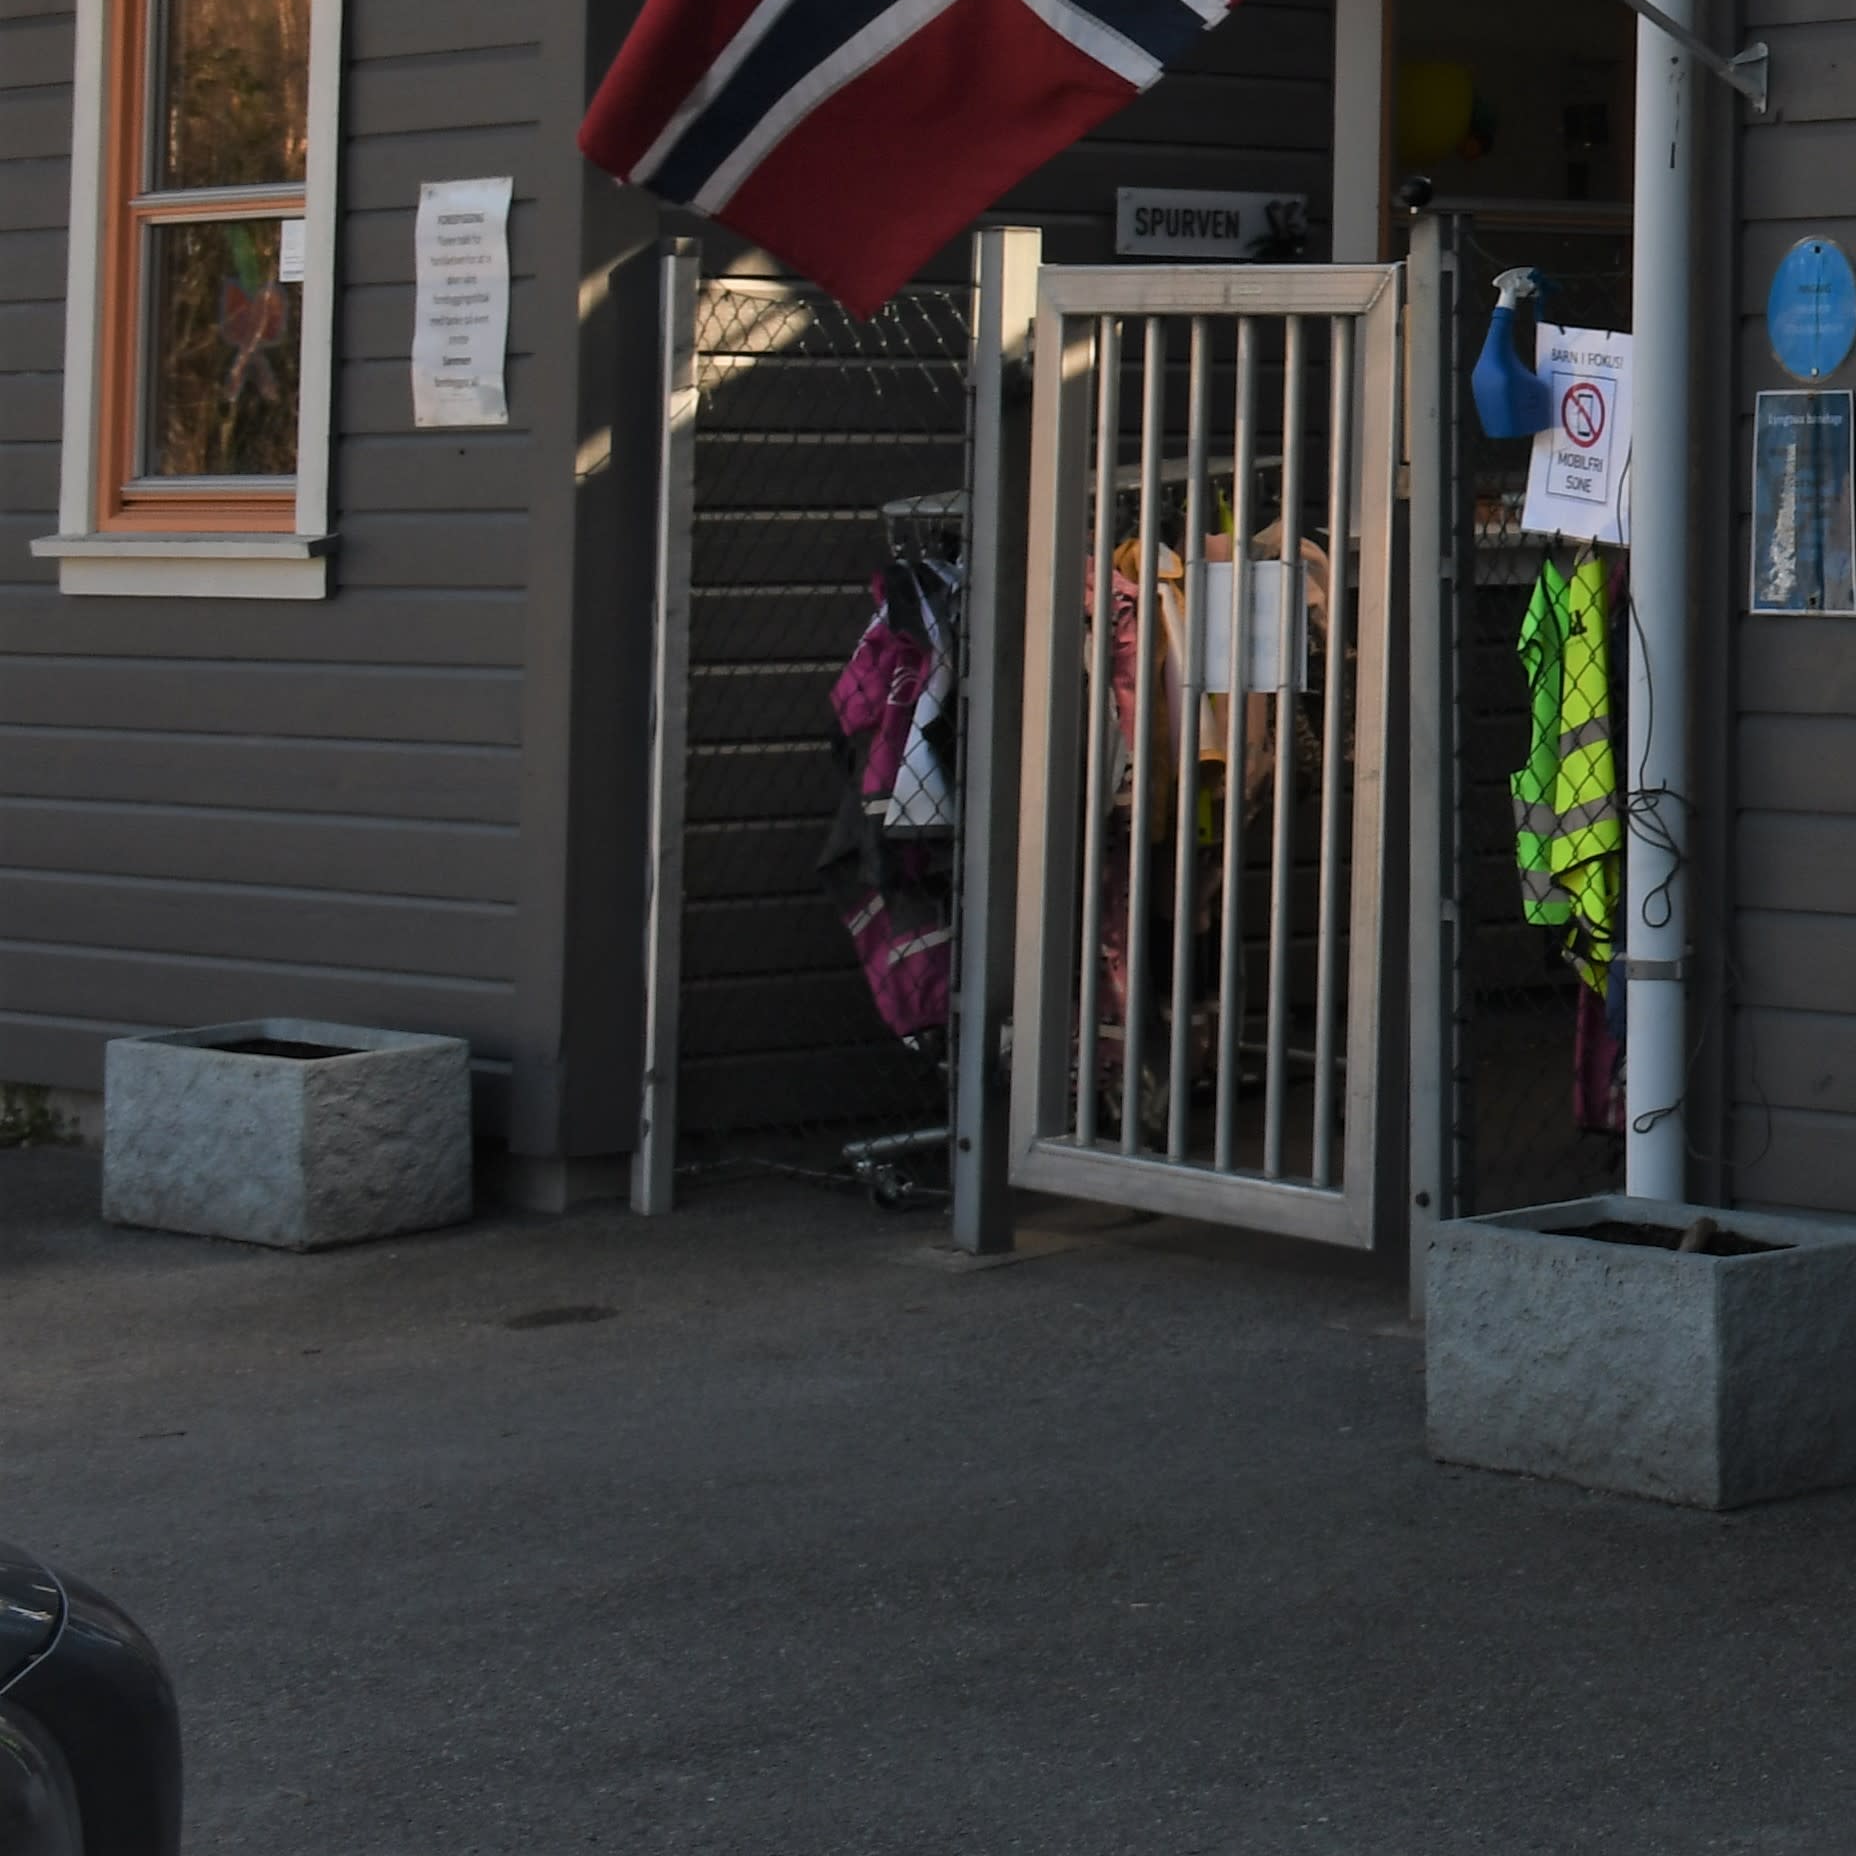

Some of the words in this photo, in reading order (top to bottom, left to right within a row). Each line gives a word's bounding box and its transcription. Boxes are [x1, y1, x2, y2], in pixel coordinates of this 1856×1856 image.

[1135, 207, 1241, 240] SPURVEN
[1557, 451, 1603, 473] MOBILFRI
[1565, 475, 1593, 493] SONE
